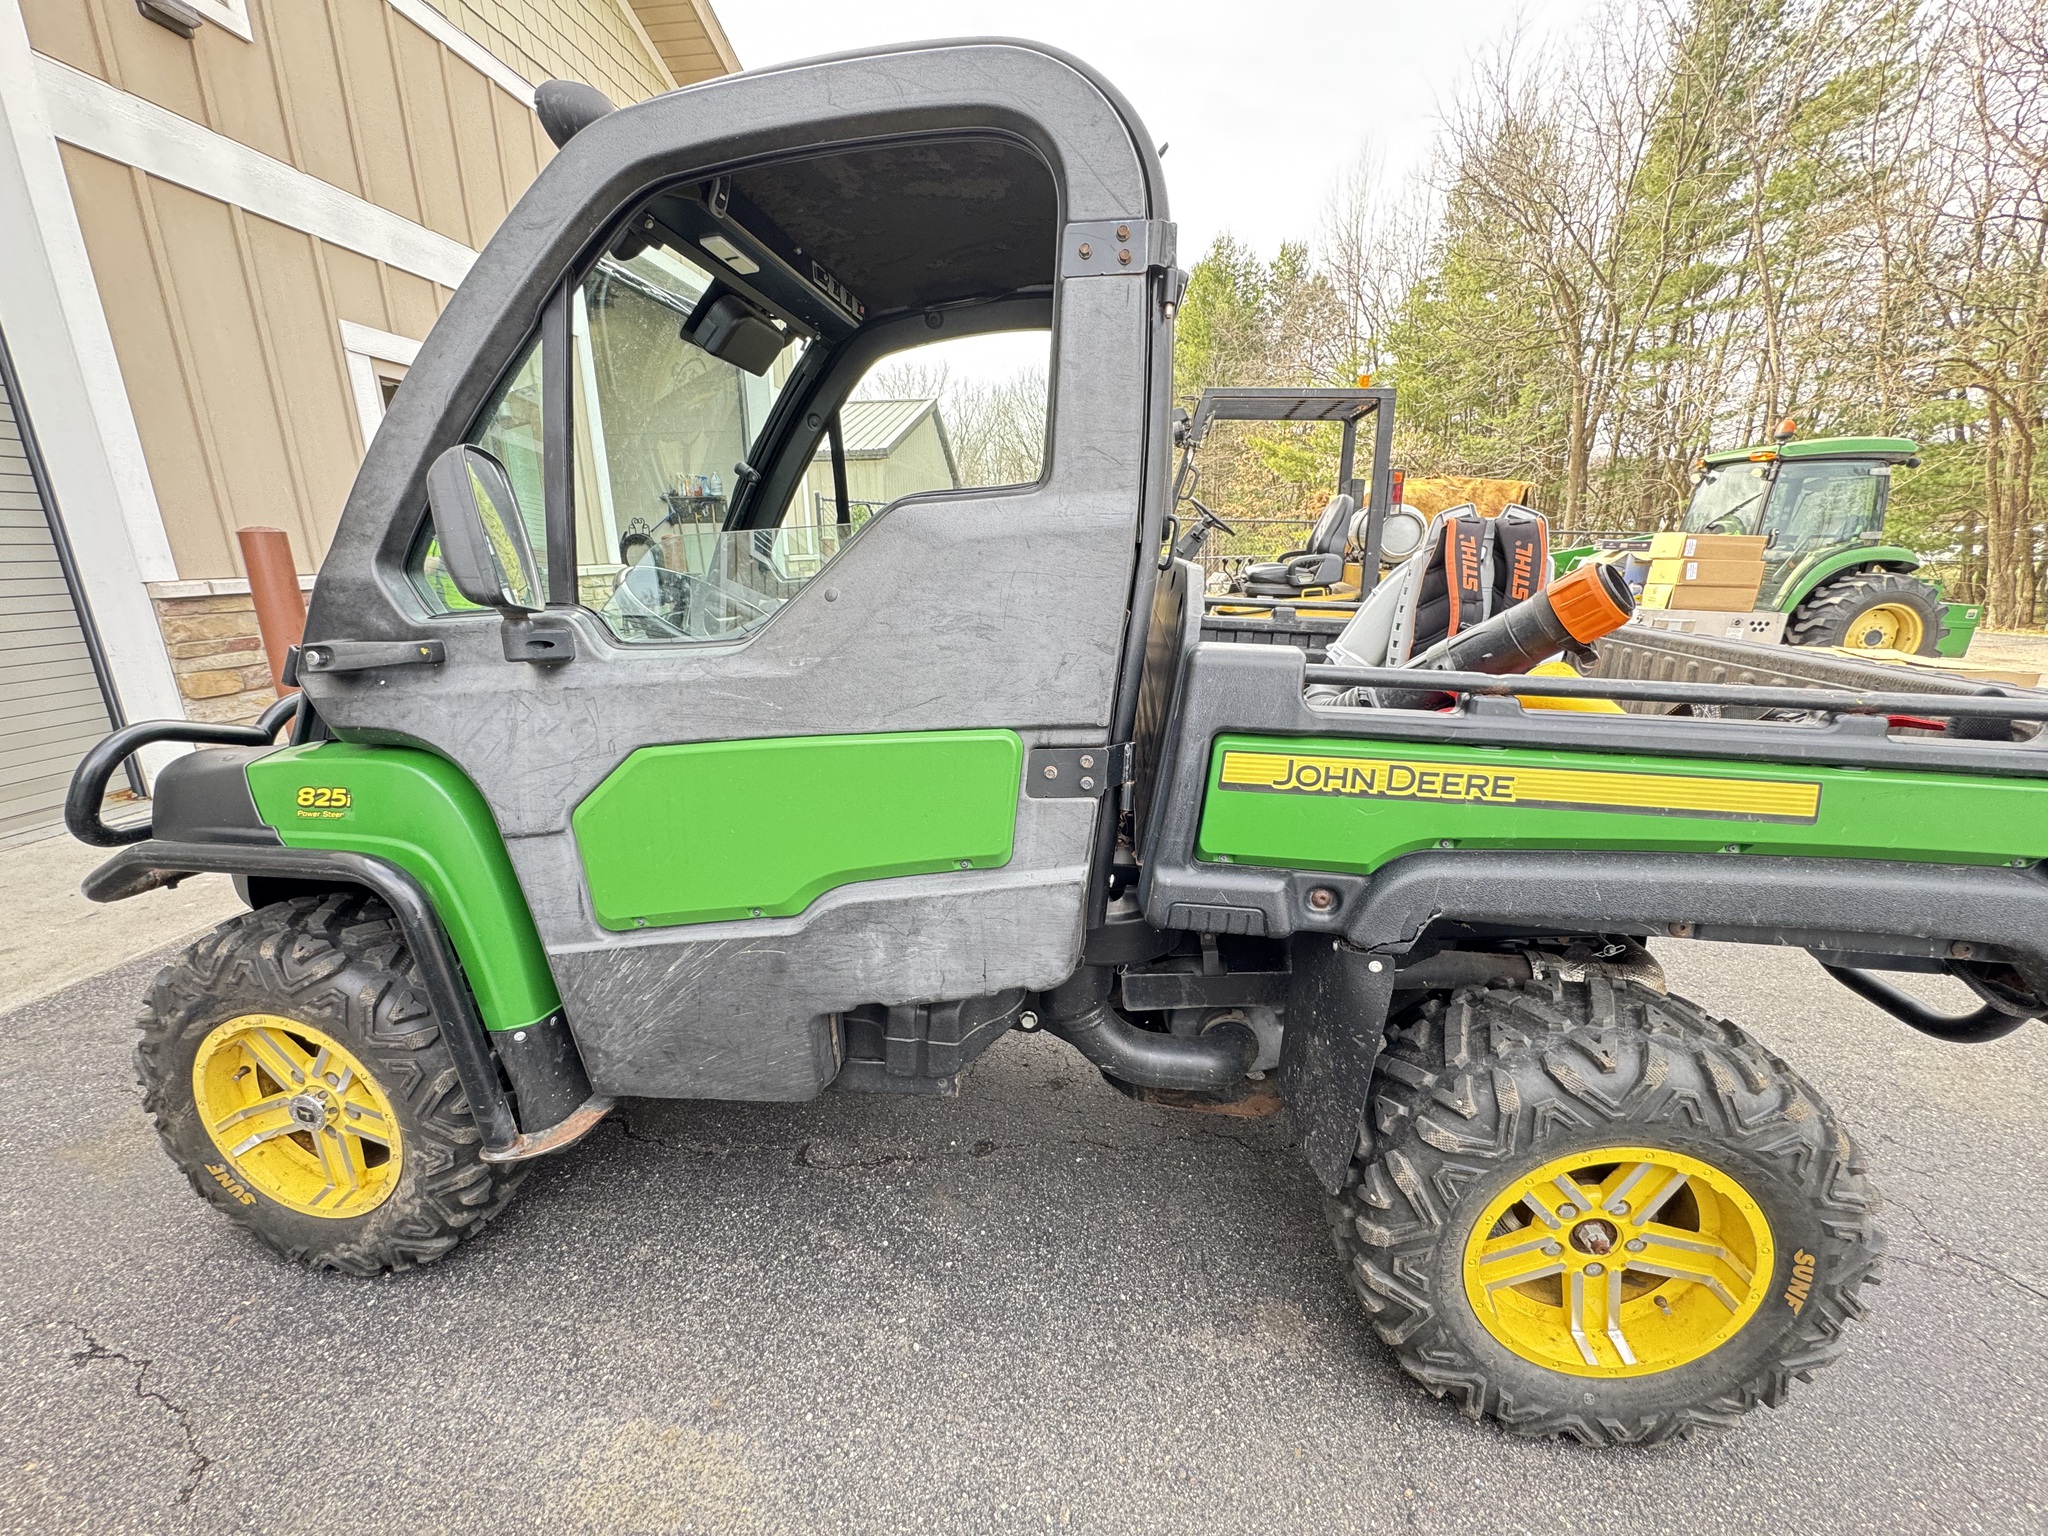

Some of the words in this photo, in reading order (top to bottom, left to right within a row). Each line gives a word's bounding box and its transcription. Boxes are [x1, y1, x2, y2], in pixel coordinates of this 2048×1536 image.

[1459, 535, 1479, 592] STIHL
[1512, 542, 1534, 600] STIHL
[297, 786, 352, 808] 825i
[1273, 759, 1377, 791] JOHN
[1385, 764, 1516, 799] DEERE
[297, 810, 320, 818] Power
[204, 1163, 257, 1205] SUNF
[1783, 1248, 1816, 1317] SUNF
